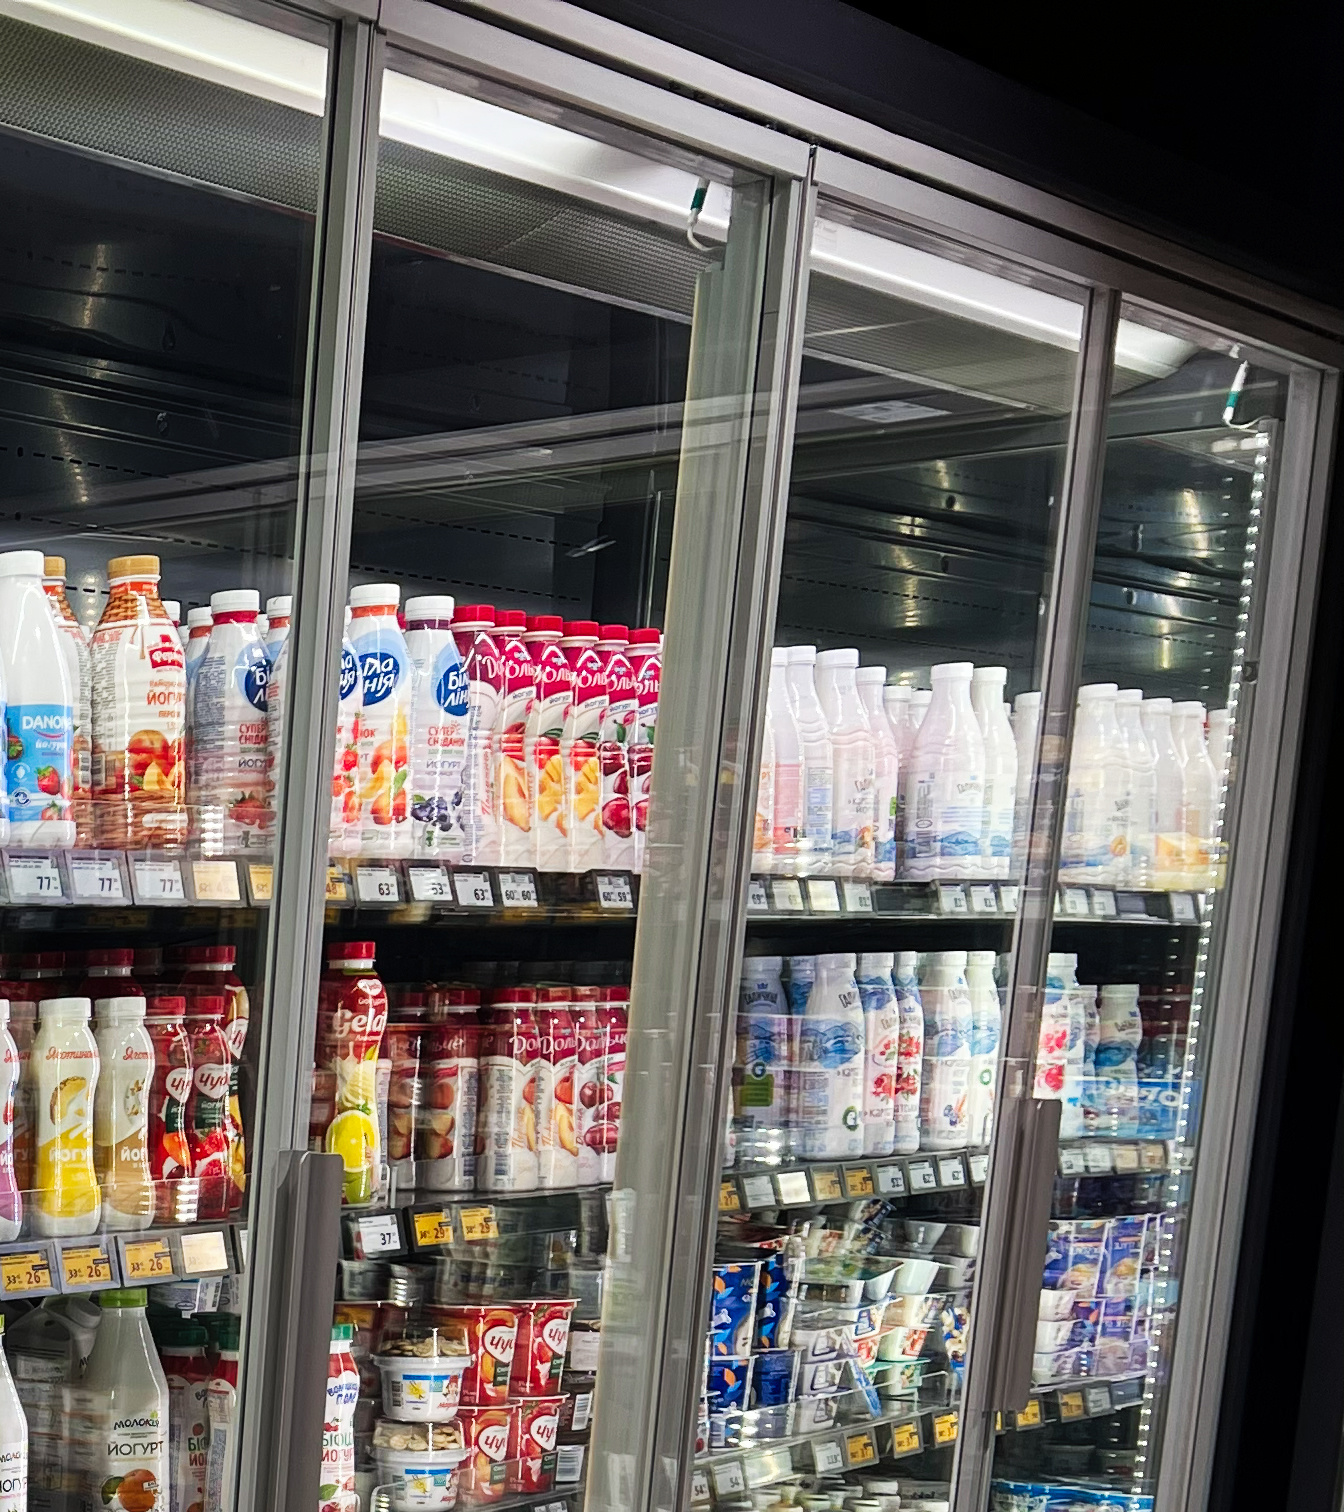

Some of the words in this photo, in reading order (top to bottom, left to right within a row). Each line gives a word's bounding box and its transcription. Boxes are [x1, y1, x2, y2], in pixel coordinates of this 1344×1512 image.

[36, 875, 51, 892] 77
[26, 1270, 42, 1286] 26
[108, 1439, 165, 1457] ЙОГУРТ
